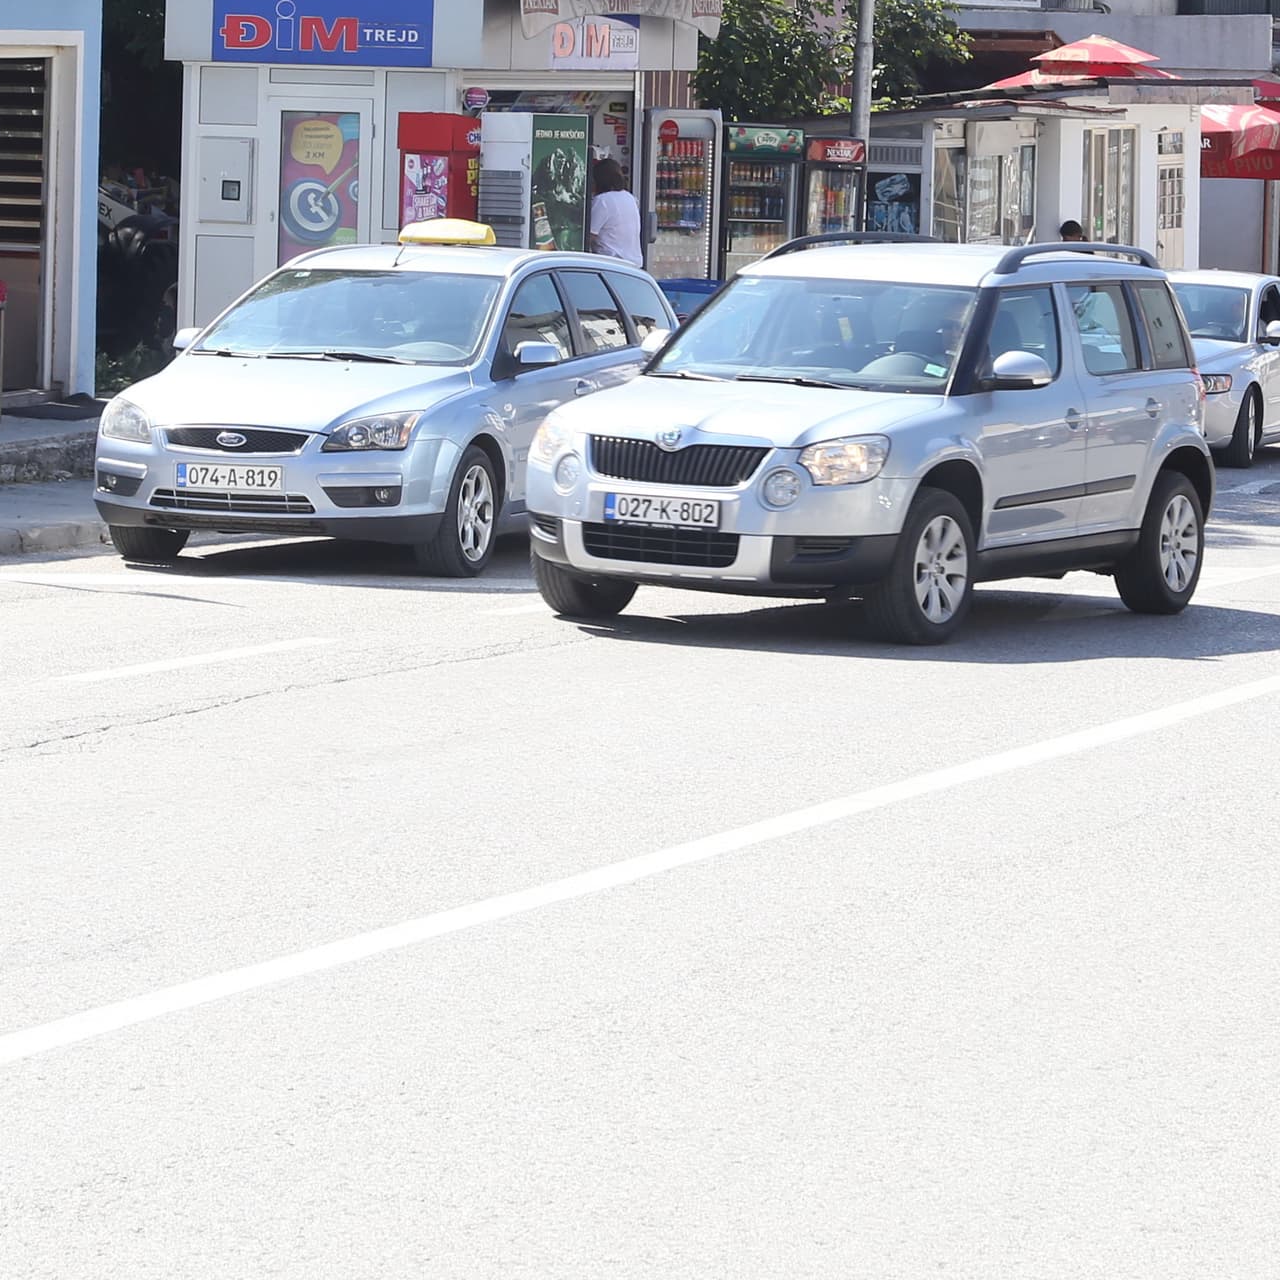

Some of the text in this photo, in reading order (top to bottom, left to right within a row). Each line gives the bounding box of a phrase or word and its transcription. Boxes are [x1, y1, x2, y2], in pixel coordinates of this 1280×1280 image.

[363, 29, 419, 43] TREJD
[188, 467, 278, 487] 074-A-819
[617, 497, 715, 524] 027-K-802
